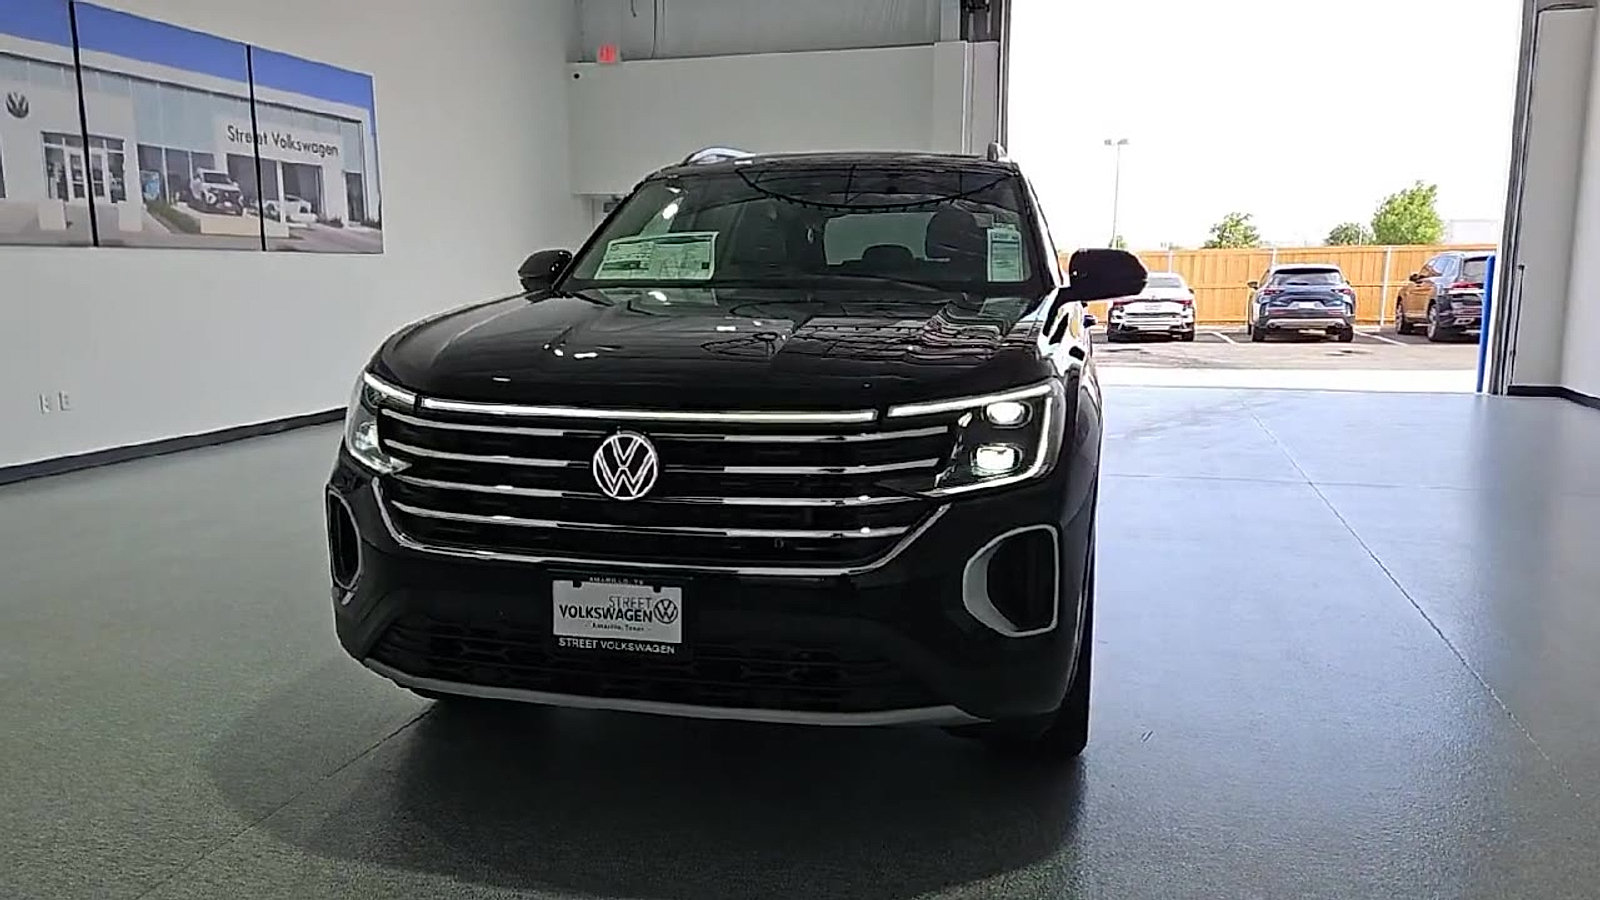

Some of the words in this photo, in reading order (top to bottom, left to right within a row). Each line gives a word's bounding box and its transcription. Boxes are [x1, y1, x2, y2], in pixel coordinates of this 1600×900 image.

[272, 131, 339, 157] Volkswagen
[608, 596, 652, 609] STREET
[559, 604, 653, 623] VOLKSWAGEN
[559, 638, 598, 649] STREET
[600, 641, 675, 654] VOLKSWAGEN
